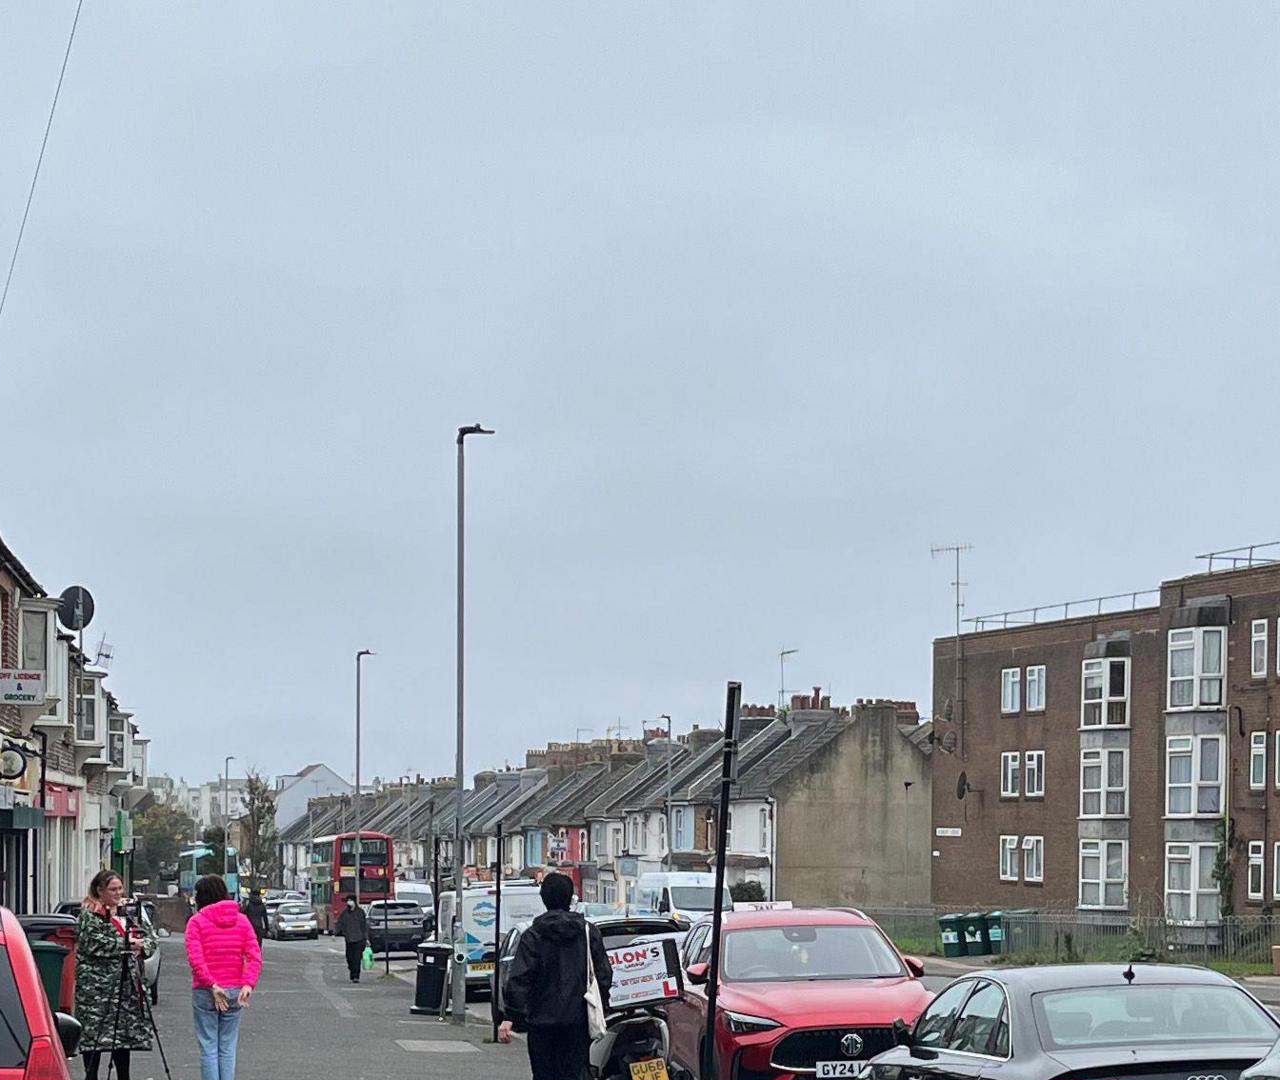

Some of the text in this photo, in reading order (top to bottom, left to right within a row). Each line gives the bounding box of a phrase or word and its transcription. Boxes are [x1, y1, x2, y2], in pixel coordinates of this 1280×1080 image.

[0, 672, 41, 680] OFF LICENCE
[16, 682, 22, 691] &
[4, 693, 36, 701] GROCERY
[662, 980, 677, 997] L
[822, 1063, 855, 1076] GY24
